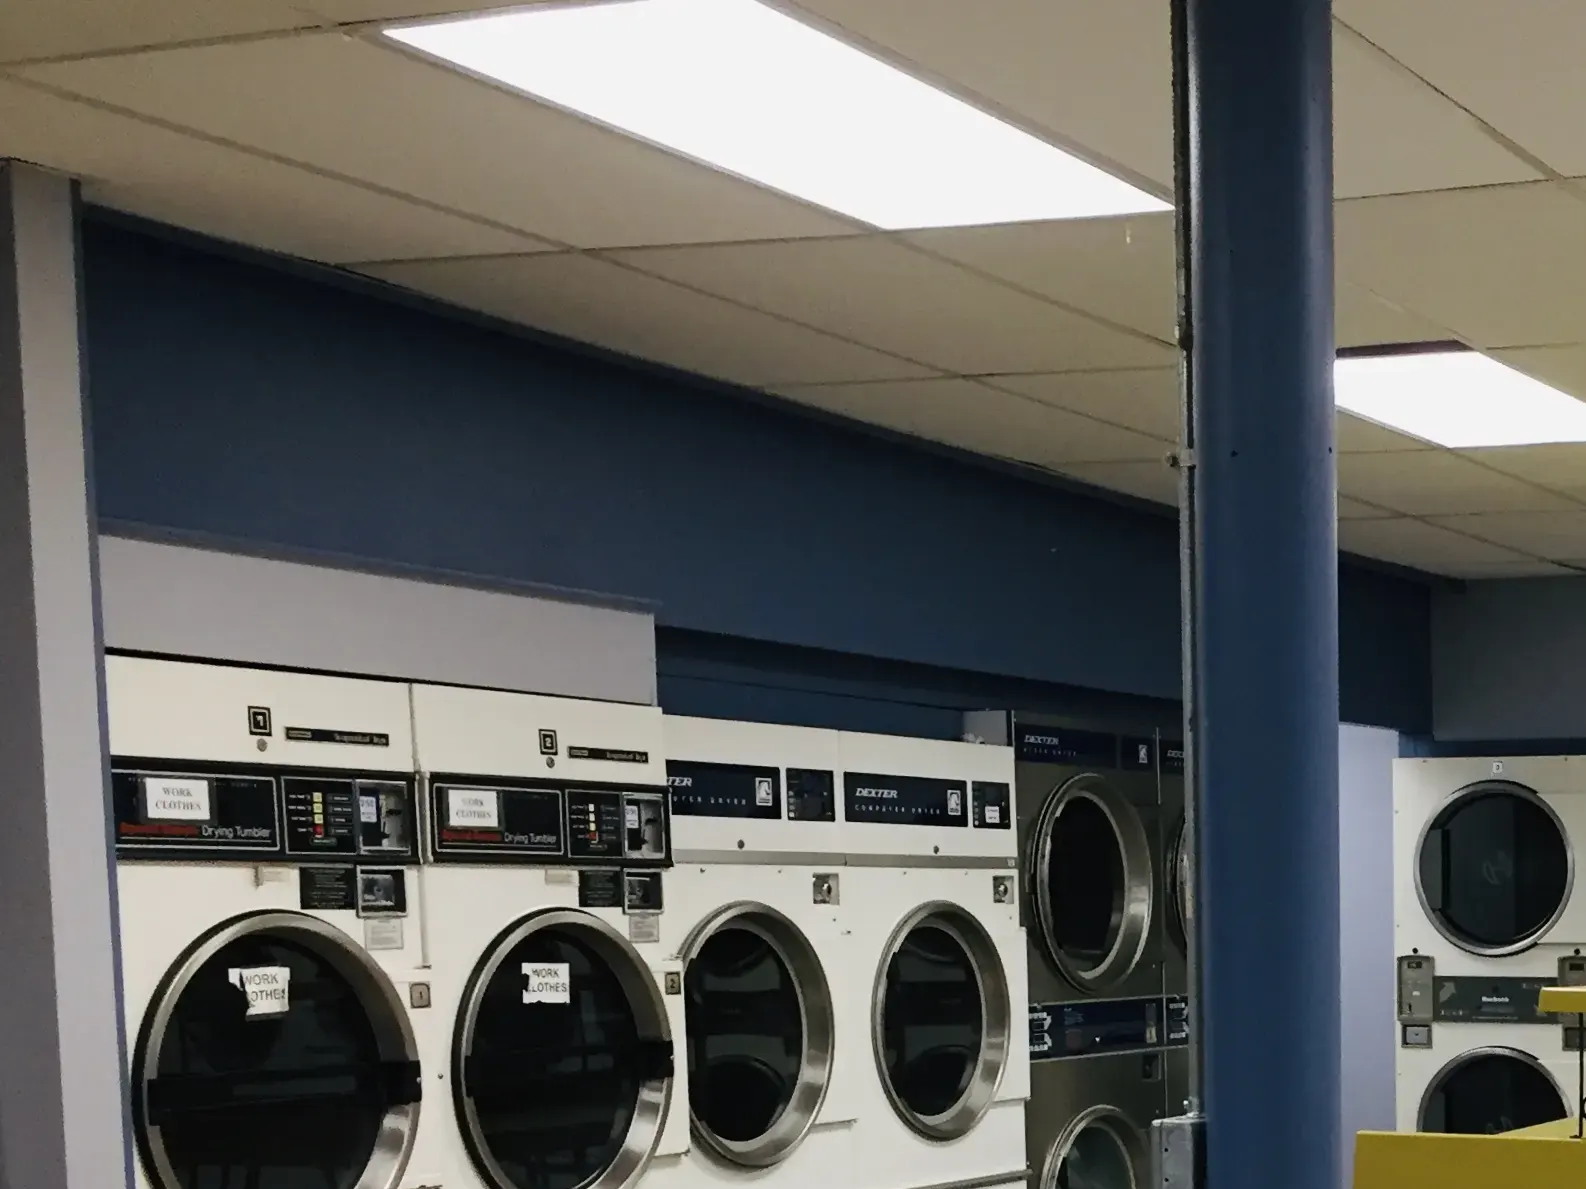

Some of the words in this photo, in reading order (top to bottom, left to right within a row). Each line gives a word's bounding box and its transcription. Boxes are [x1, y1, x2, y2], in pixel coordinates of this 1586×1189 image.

[544, 737, 552, 747] 2
[667, 776, 693, 787] TER
[162, 787, 193, 797] WORK
[855, 787, 898, 799] DEXTER
[155, 799, 202, 811] CLOTHES
[201, 825, 234, 838] Drying
[235, 826, 272, 838] Tumbler
[504, 832, 529, 845] Drying
[531, 968, 559, 978] WORK
[244, 973, 279, 986] WORK
[670, 978, 676, 989] 2
